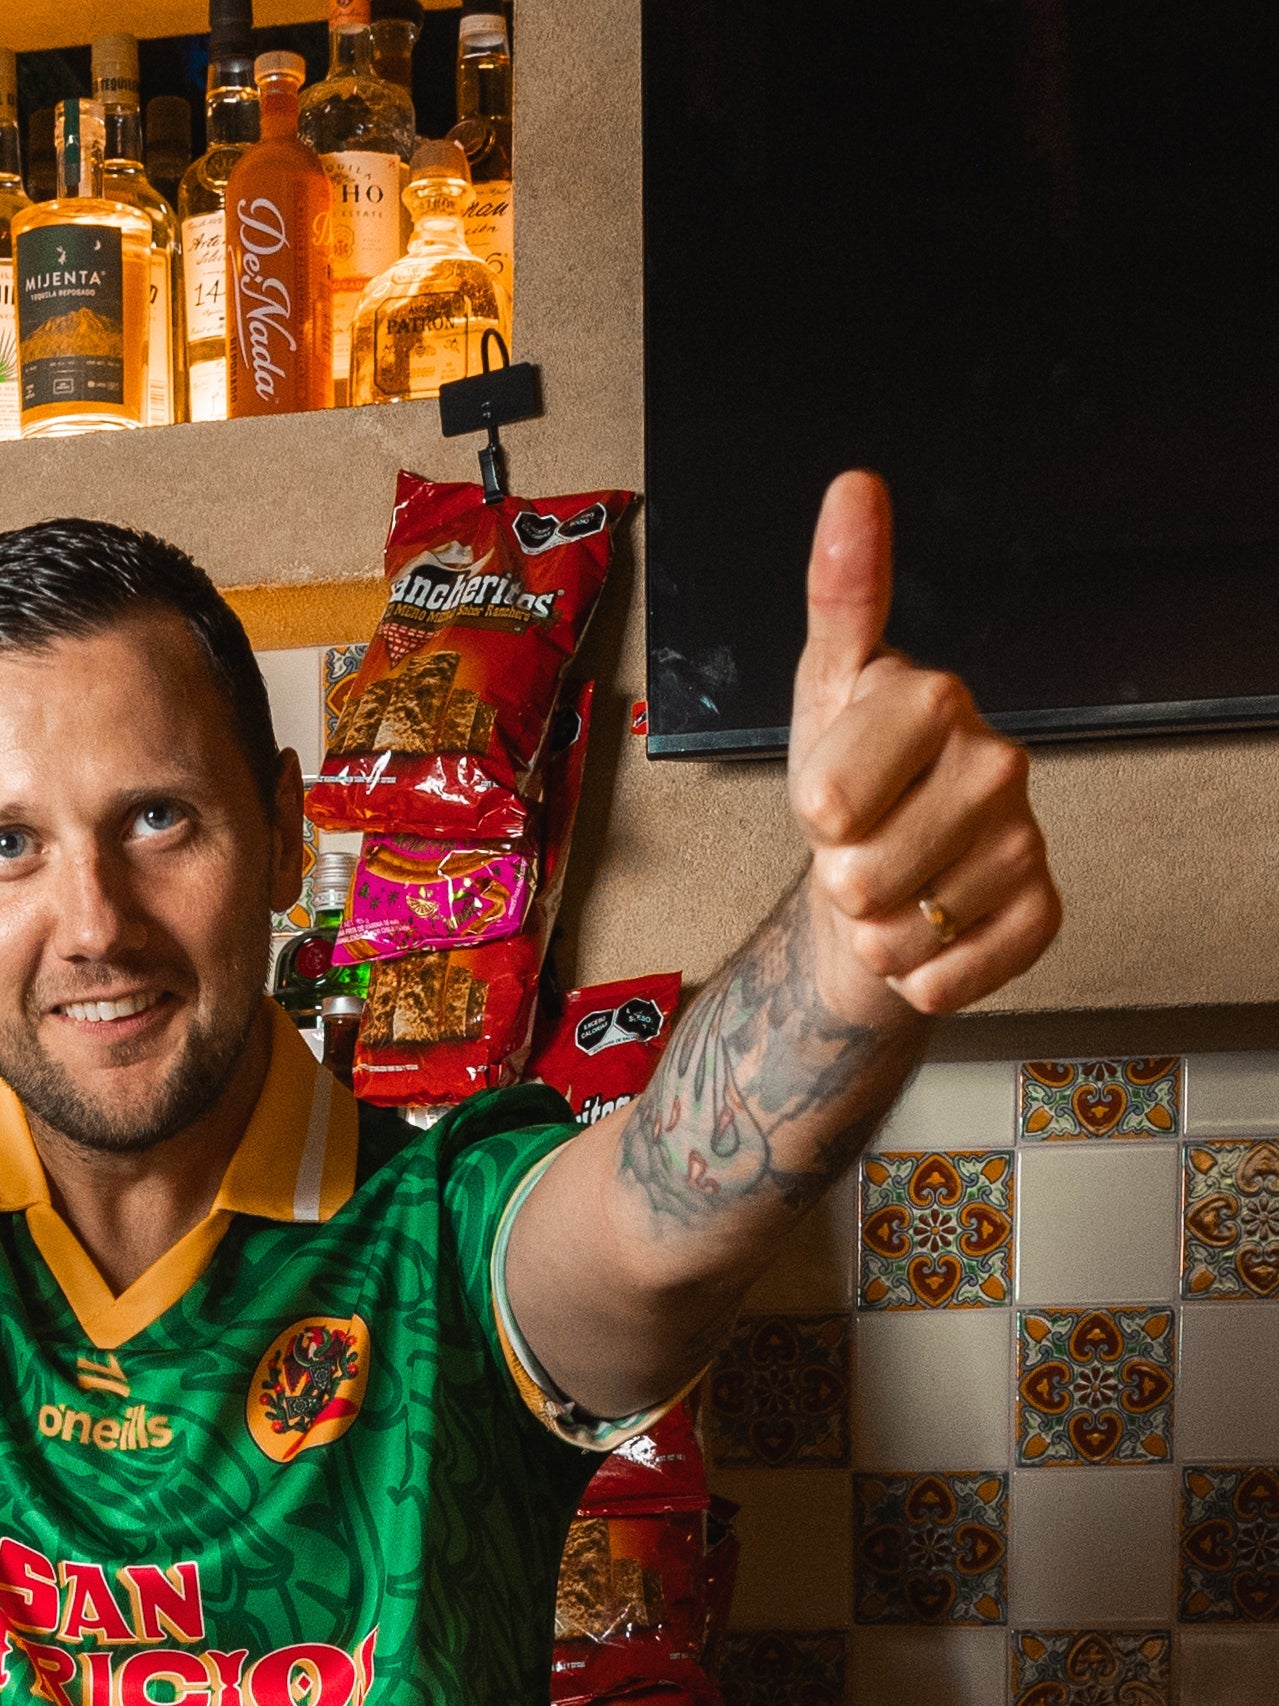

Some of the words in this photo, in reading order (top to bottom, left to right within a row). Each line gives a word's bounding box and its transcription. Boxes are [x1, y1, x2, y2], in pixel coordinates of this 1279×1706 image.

[25, 269, 101, 292] MIJENTA
[30, 290, 58, 301] TEQUILA
[58, 288, 96, 298] REPOSADO
